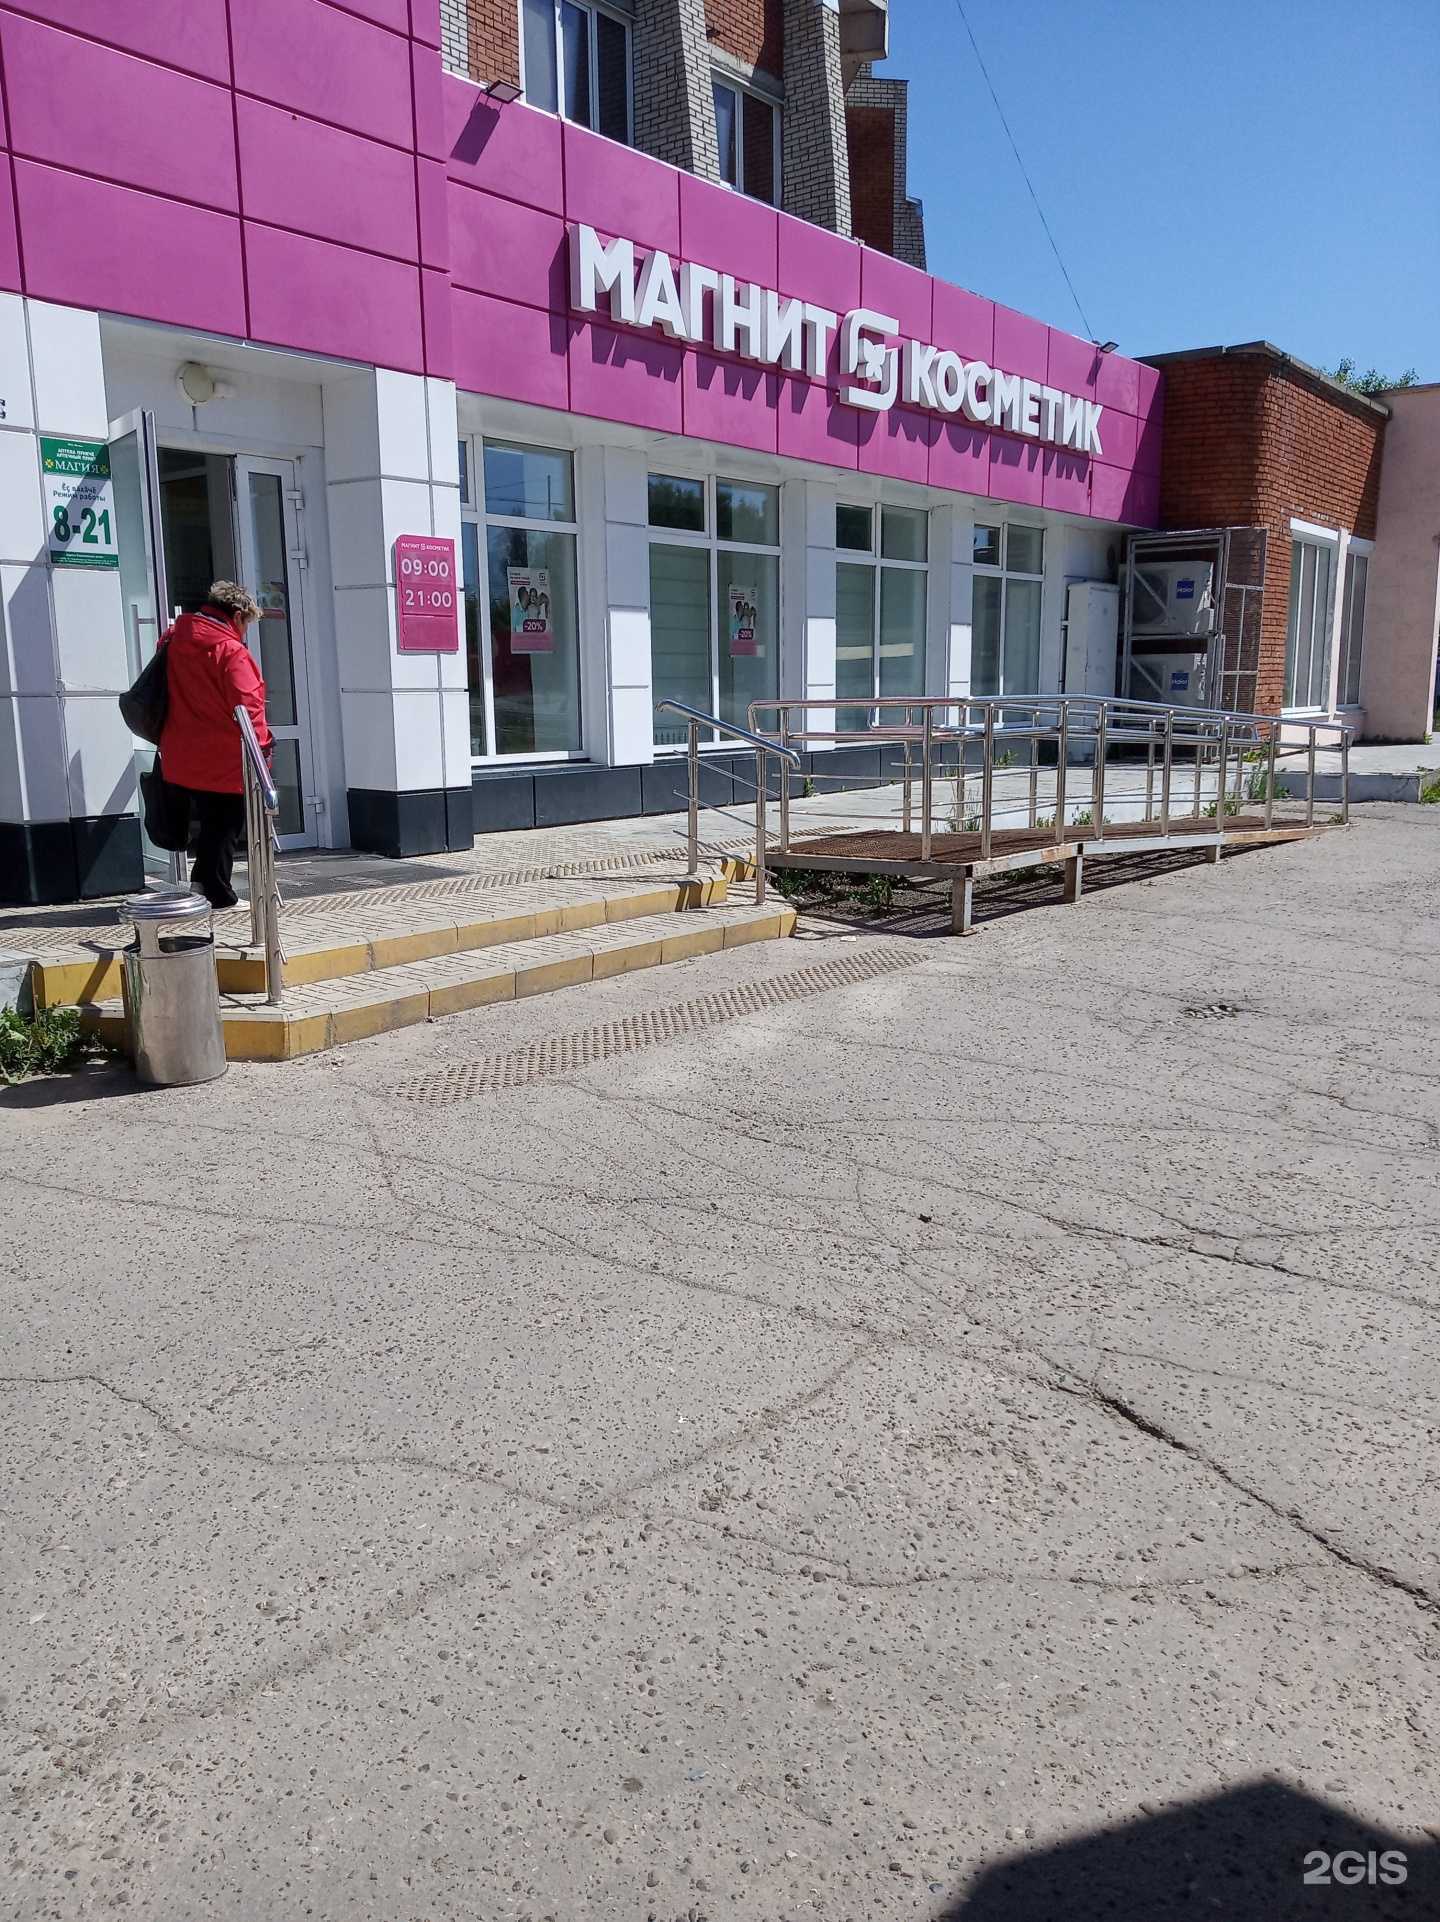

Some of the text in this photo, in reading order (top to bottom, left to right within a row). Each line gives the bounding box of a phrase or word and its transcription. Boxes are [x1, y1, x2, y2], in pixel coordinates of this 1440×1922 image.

[570, 223, 1104, 456] МАГНИТ КОСМЕТИК
[55, 459, 100, 474] МАГИЯ
[53, 490, 106, 502] Режим работы
[53, 505, 112, 545] 8-21
[401, 542, 420, 550] МАГНИТ
[402, 558, 449, 577] 09:00
[405, 589, 452, 608] 21:00
[524, 621, 543, 632] -20%
